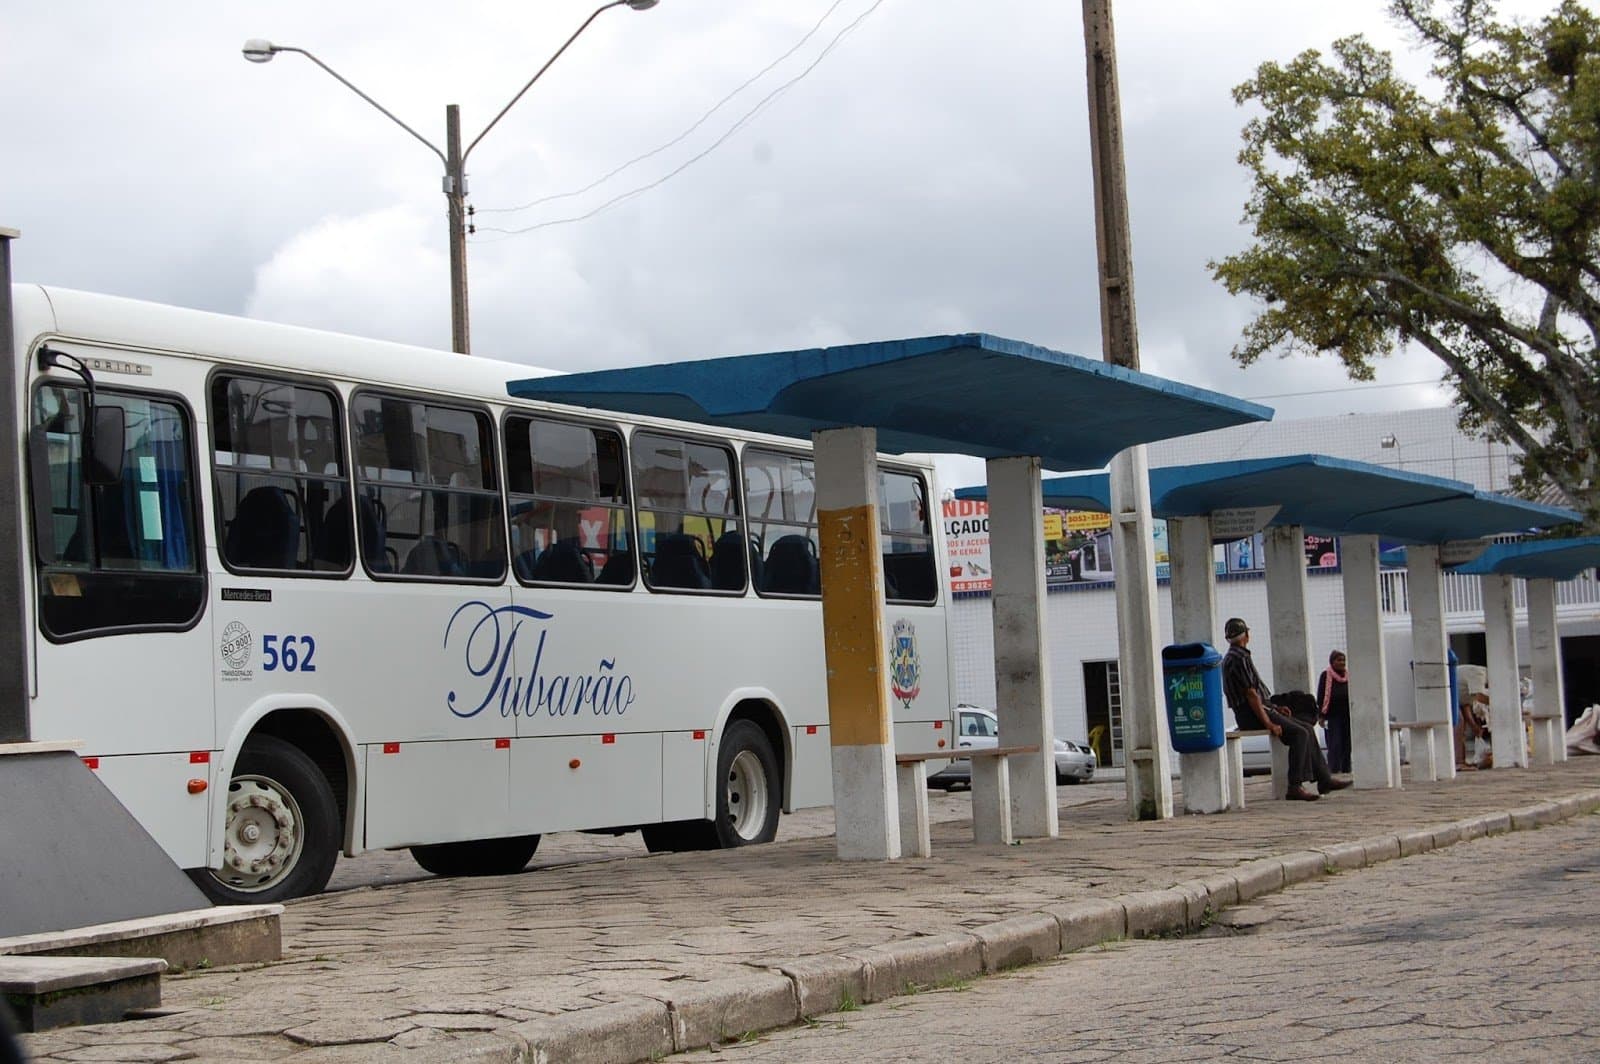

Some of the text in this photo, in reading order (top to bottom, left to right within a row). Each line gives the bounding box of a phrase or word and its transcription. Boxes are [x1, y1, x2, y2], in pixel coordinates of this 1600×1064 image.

[223, 589, 271, 601] Mercedes-Benz
[236, 633, 252, 650] 9001
[263, 634, 316, 672] 562
[444, 600, 635, 718] Tubarão
